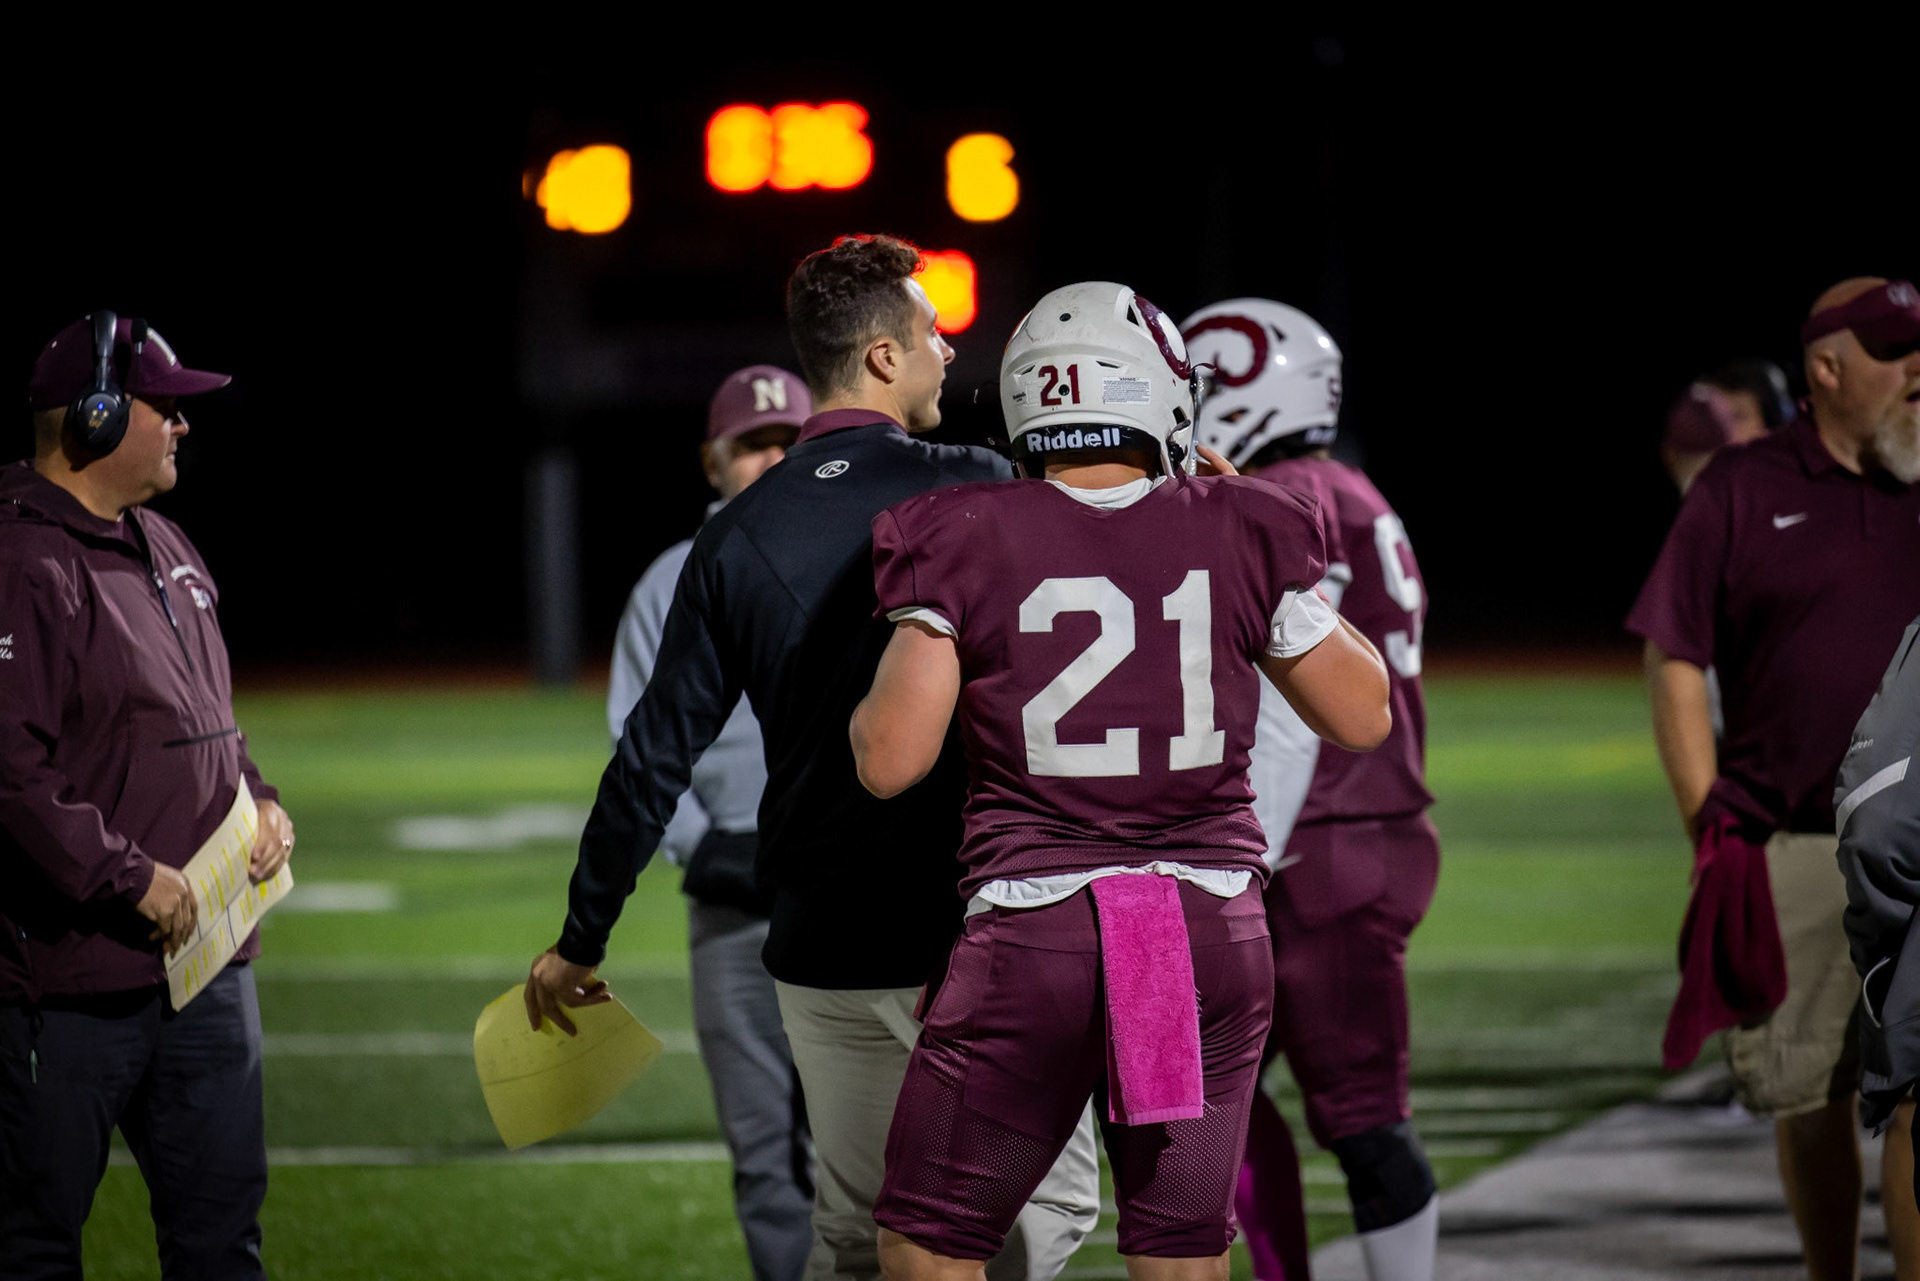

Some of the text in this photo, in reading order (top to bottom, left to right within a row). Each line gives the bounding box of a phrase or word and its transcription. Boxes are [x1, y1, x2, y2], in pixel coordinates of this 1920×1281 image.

[751, 378, 786, 412] N
[1038, 364, 1080, 407] 21
[1026, 427, 1120, 453] Riddell
[1019, 569, 1226, 777] 21
